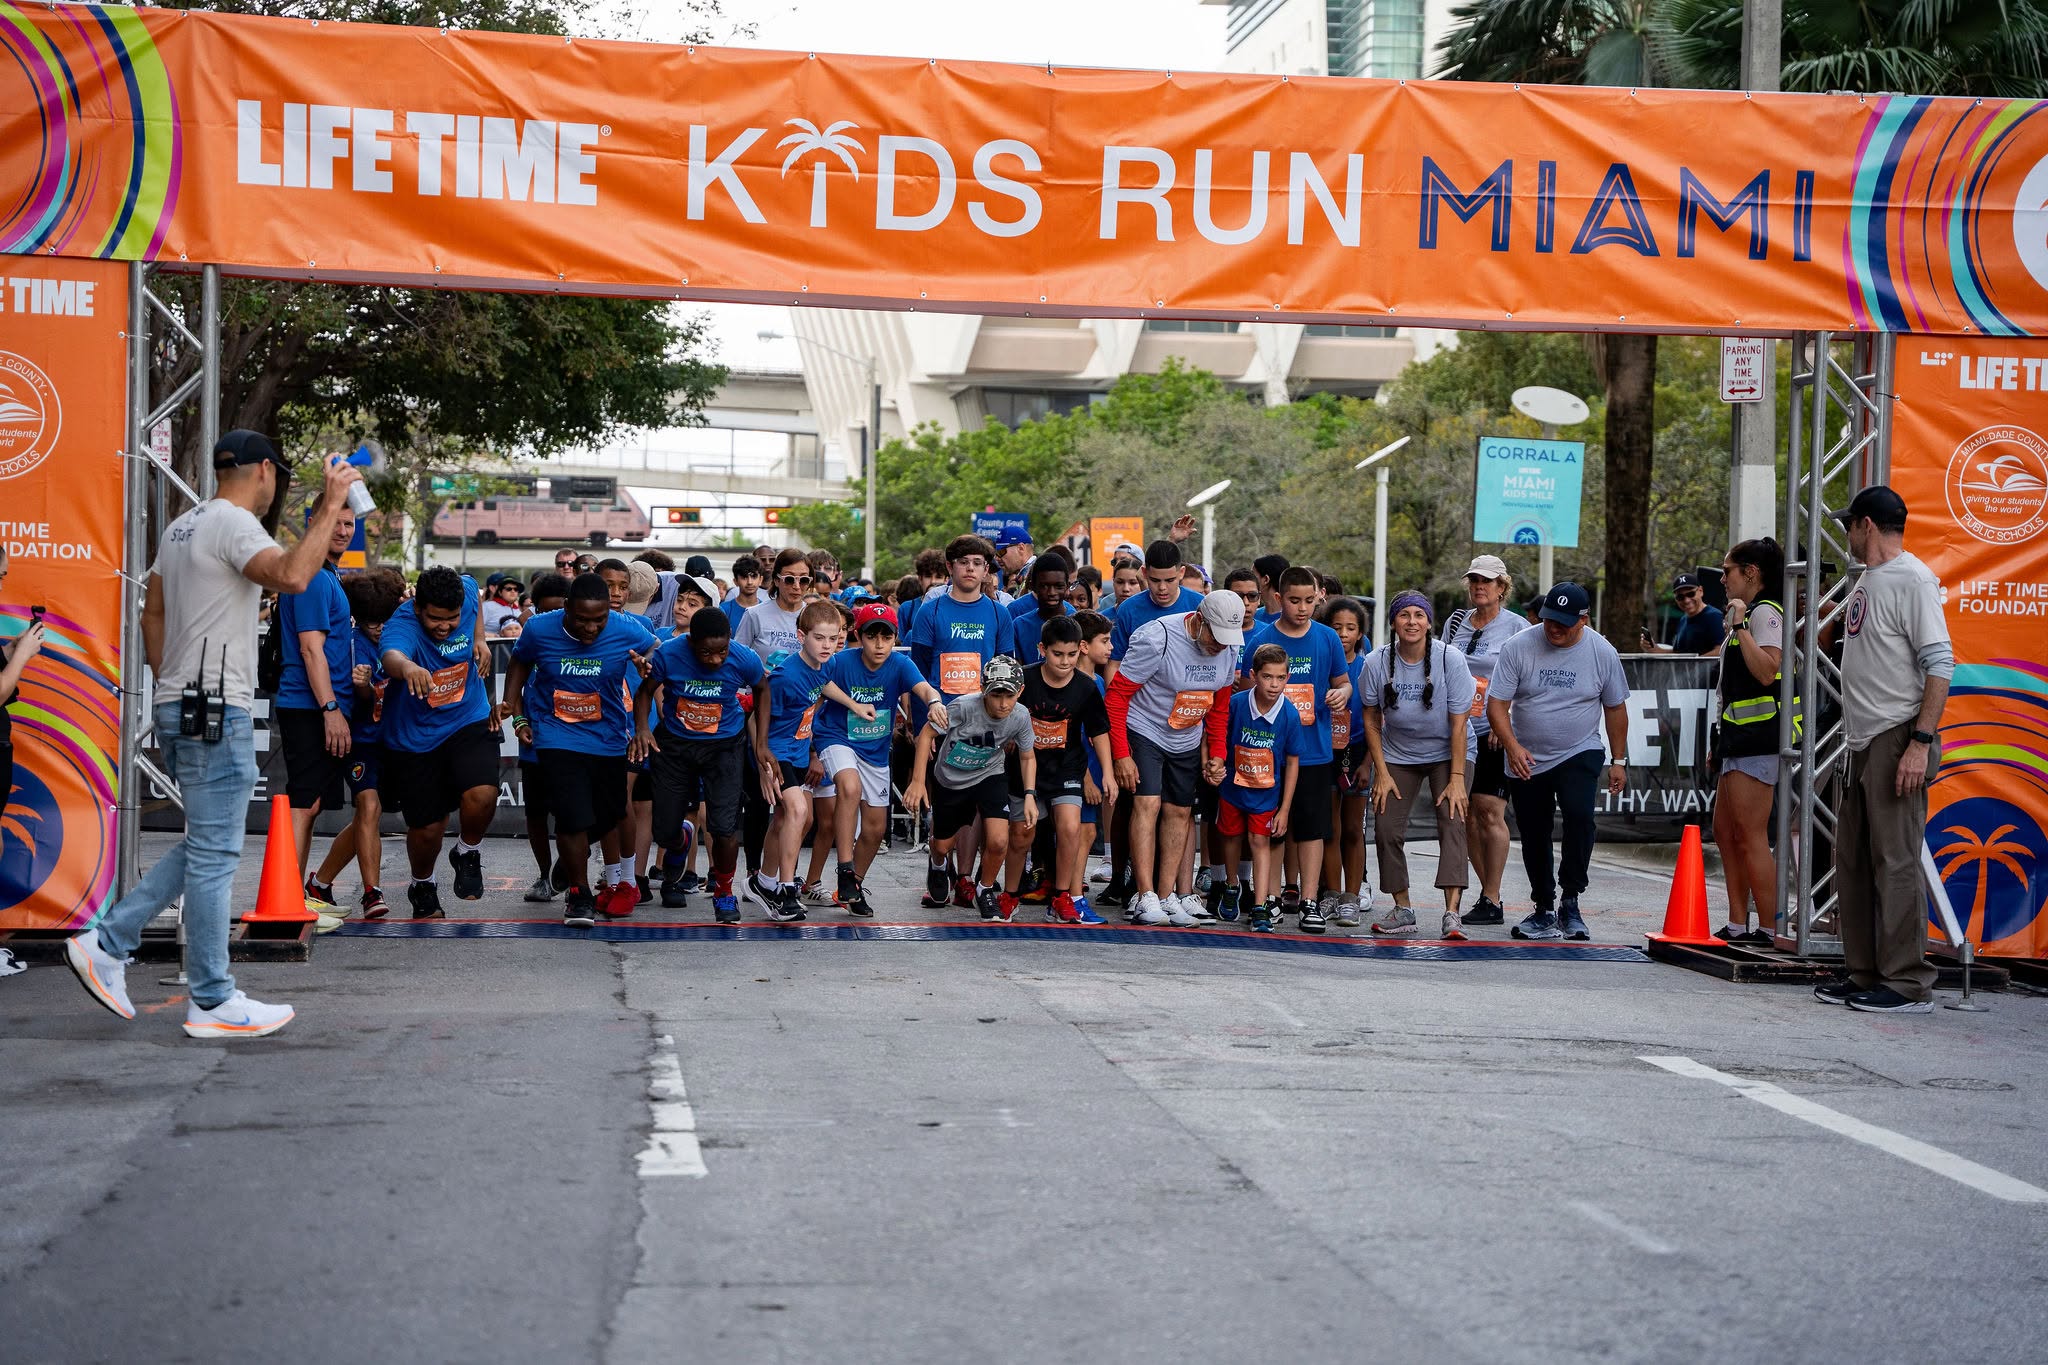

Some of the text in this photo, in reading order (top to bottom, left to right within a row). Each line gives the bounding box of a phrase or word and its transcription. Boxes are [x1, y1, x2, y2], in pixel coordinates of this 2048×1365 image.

[238, 100, 599, 206] LIFE TIME
[686, 118, 1815, 262] KIDS RUN MIAMI
[9, 277, 94, 317] TIME
[1726, 345, 1761, 355] PARKING
[1735, 357, 1752, 366] ANY
[6, 359, 47, 389] COUNTY
[1734, 368, 1752, 377] TIME
[1960, 355, 2019, 390] LIFE
[1961, 431, 2015, 457] MIAMI-DADE
[1486, 445, 1577, 463] CORRAL A
[1503, 475, 1555, 491] MIAMI
[1503, 490, 1555, 500] KIDS MILE
[1966, 495, 2042, 506] giving our students
[1985, 504, 2022, 514] the world
[0, 521, 50, 538] TIME
[1961, 513, 2044, 541] PUBLIC SCHOOLS
[1960, 580, 2048, 598] LIFE TIME
[950, 627, 985, 639] Miami
[561, 657, 581, 665] KIDS
[560, 662, 602, 676] Miami
[944, 670, 977, 679] 40419
[432, 677, 464, 693] 40527
[852, 724, 886, 734] 41669
[1260, 731, 1276, 739] RUN
[1238, 763, 1270, 774] 40414
